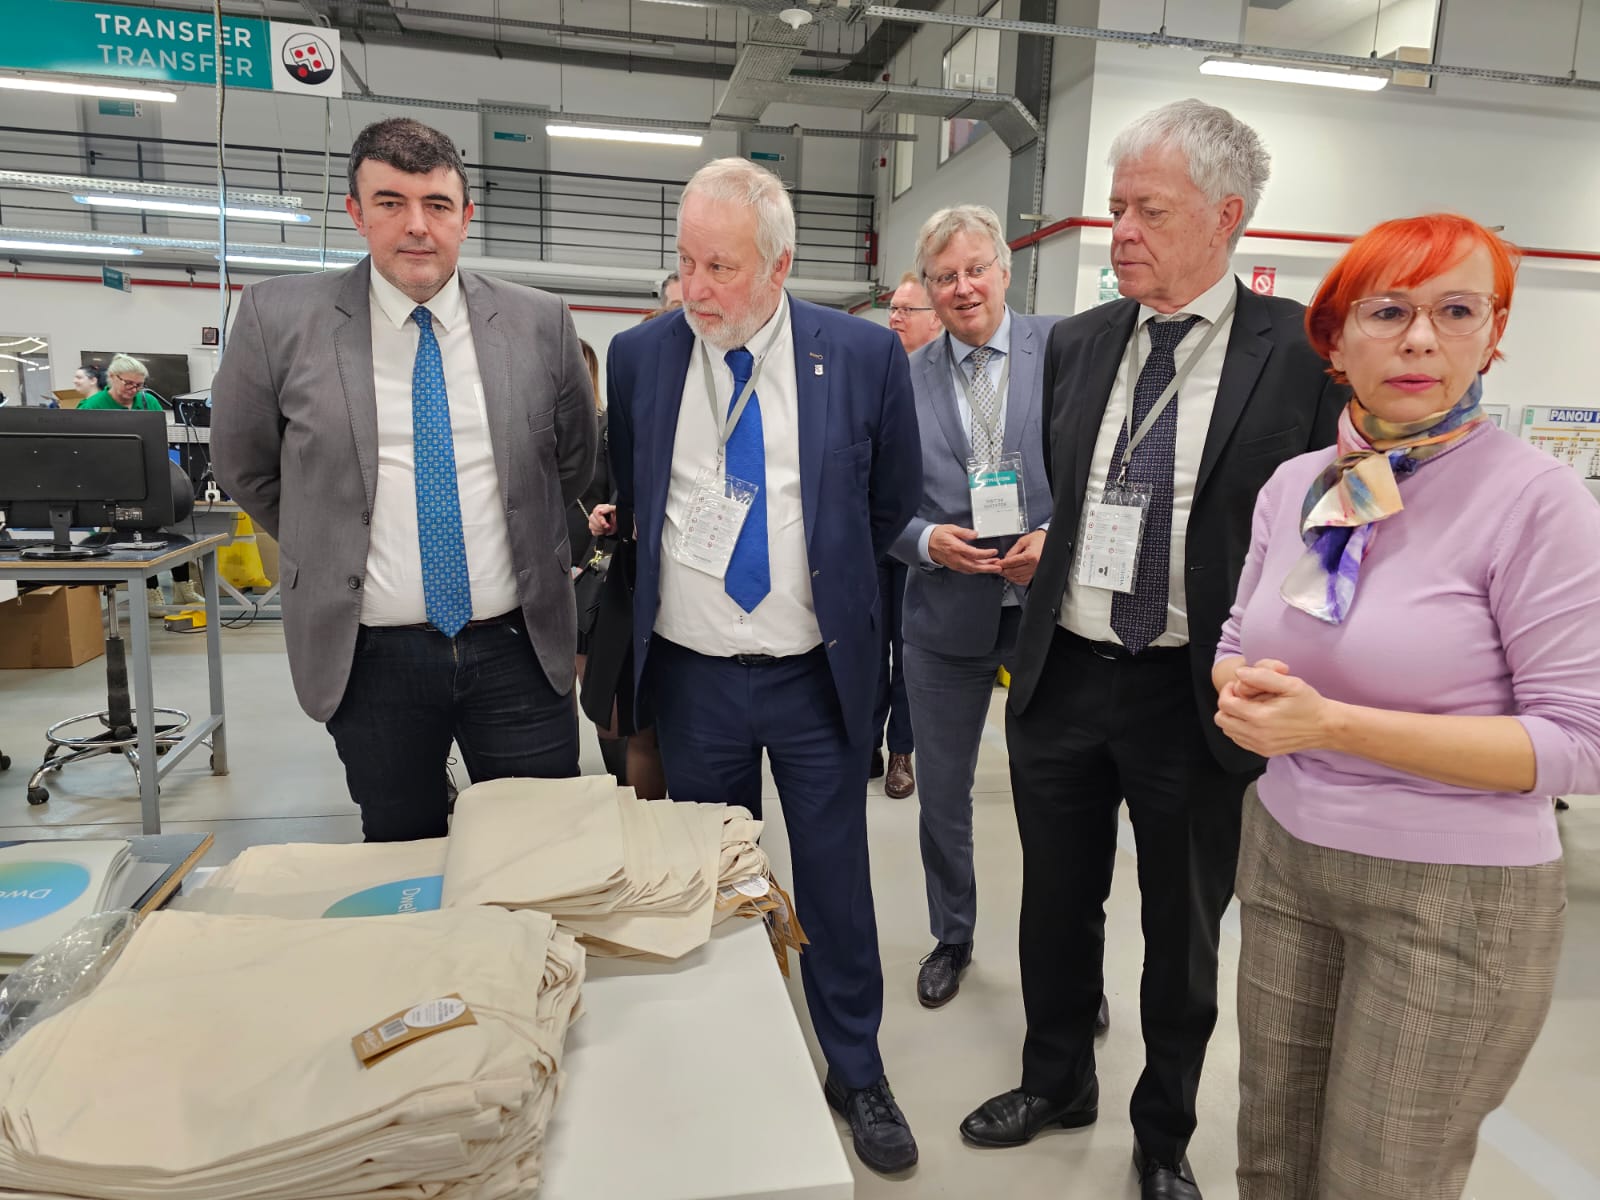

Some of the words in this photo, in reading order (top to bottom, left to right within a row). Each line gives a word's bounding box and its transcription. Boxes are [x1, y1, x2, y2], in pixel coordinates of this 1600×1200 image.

[95, 13, 252, 48] TRANSFER
[97, 44, 253, 78] TRANSFER
[1550, 410, 1593, 423] PANOU
